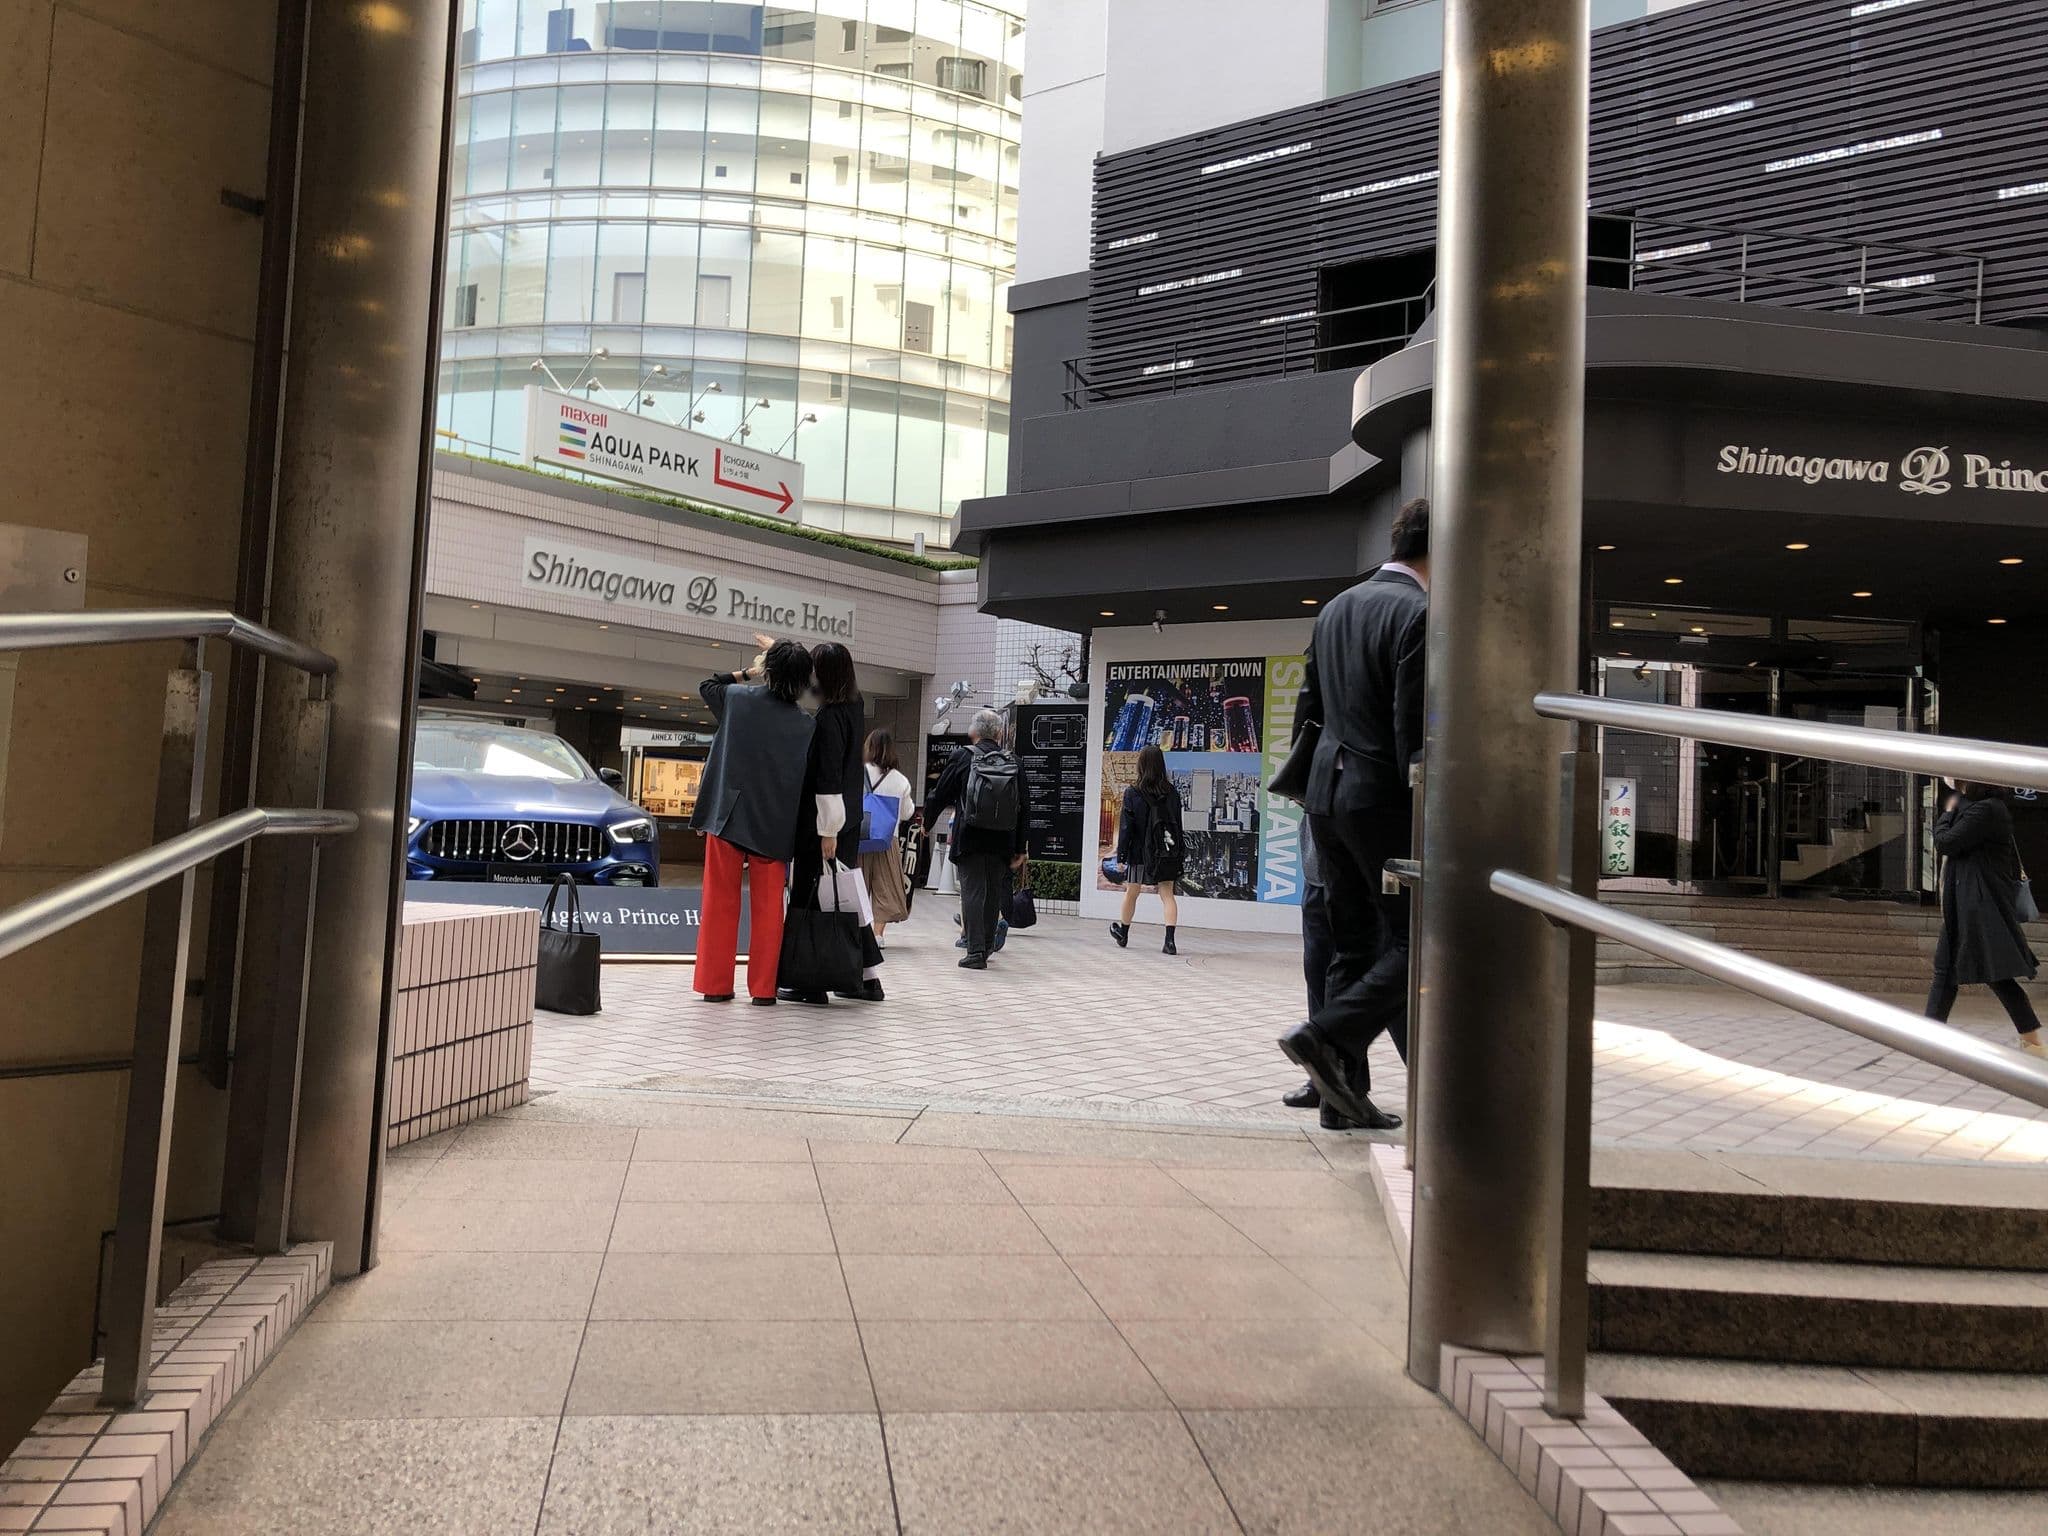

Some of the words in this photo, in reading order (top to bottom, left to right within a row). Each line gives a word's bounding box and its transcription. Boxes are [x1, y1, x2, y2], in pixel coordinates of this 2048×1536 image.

[560, 404, 608, 428] maxell
[589, 453, 644, 476] SHINAGAWA
[590, 432, 644, 463] AQUA
[649, 446, 699, 478] PARK
[723, 454, 760, 472] ICHOZAKA
[1717, 445, 1890, 485] Shinagawa
[1963, 454, 2048, 493] Princ
[527, 551, 675, 606] Shinagawa
[727, 588, 796, 627] Prince
[800, 602, 855, 638] Hotel
[1110, 663, 1218, 681] ENTERTAINMENT
[1223, 662, 1263, 678] TOWN
[651, 733, 673, 742] ANNEX
[674, 733, 697, 741] TOWER
[1609, 806, 1631, 817] 焼肉
[493, 873, 542, 884] Mercedes-AMG
[617, 908, 680, 926] Prince
[684, 909, 703, 926] H
